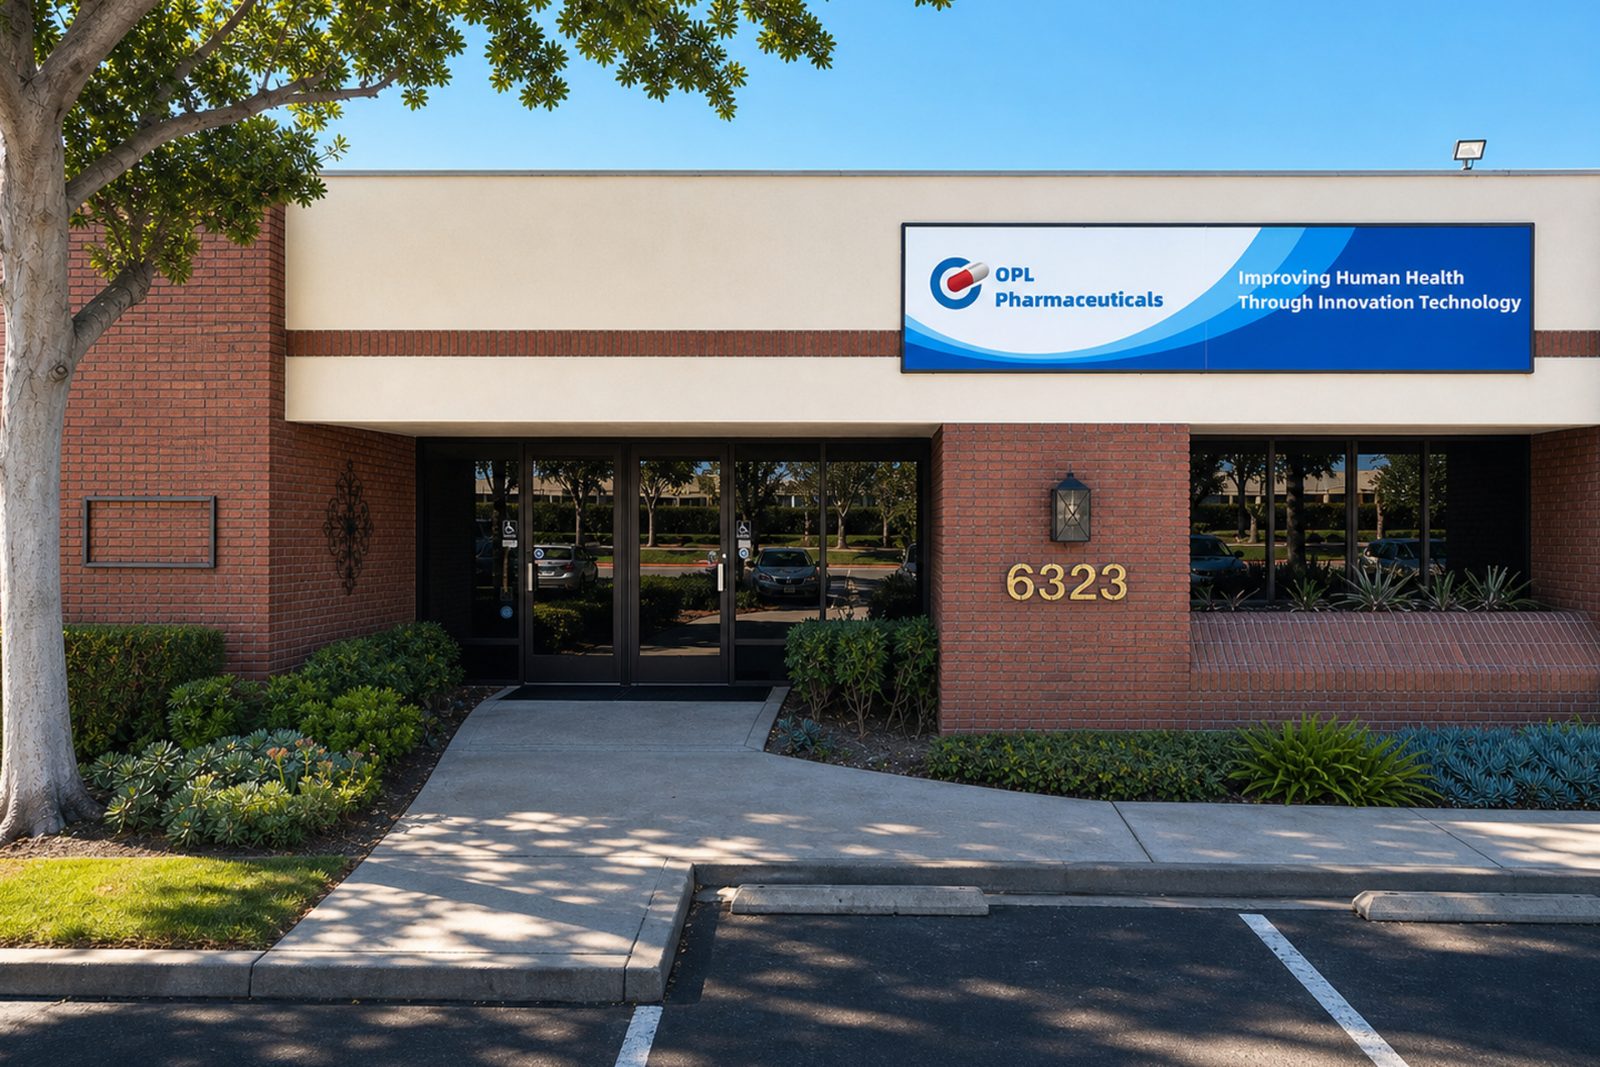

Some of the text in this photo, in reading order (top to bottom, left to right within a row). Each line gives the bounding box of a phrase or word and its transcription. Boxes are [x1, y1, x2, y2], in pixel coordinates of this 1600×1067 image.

[995, 266, 1034, 283] OPL
[1238, 270, 1464, 289] Improving Human Health
[995, 290, 1164, 308] Pharmaceuticals
[1238, 294, 1522, 313] Through Innovation Technology
[1006, 563, 1128, 601] 6323
